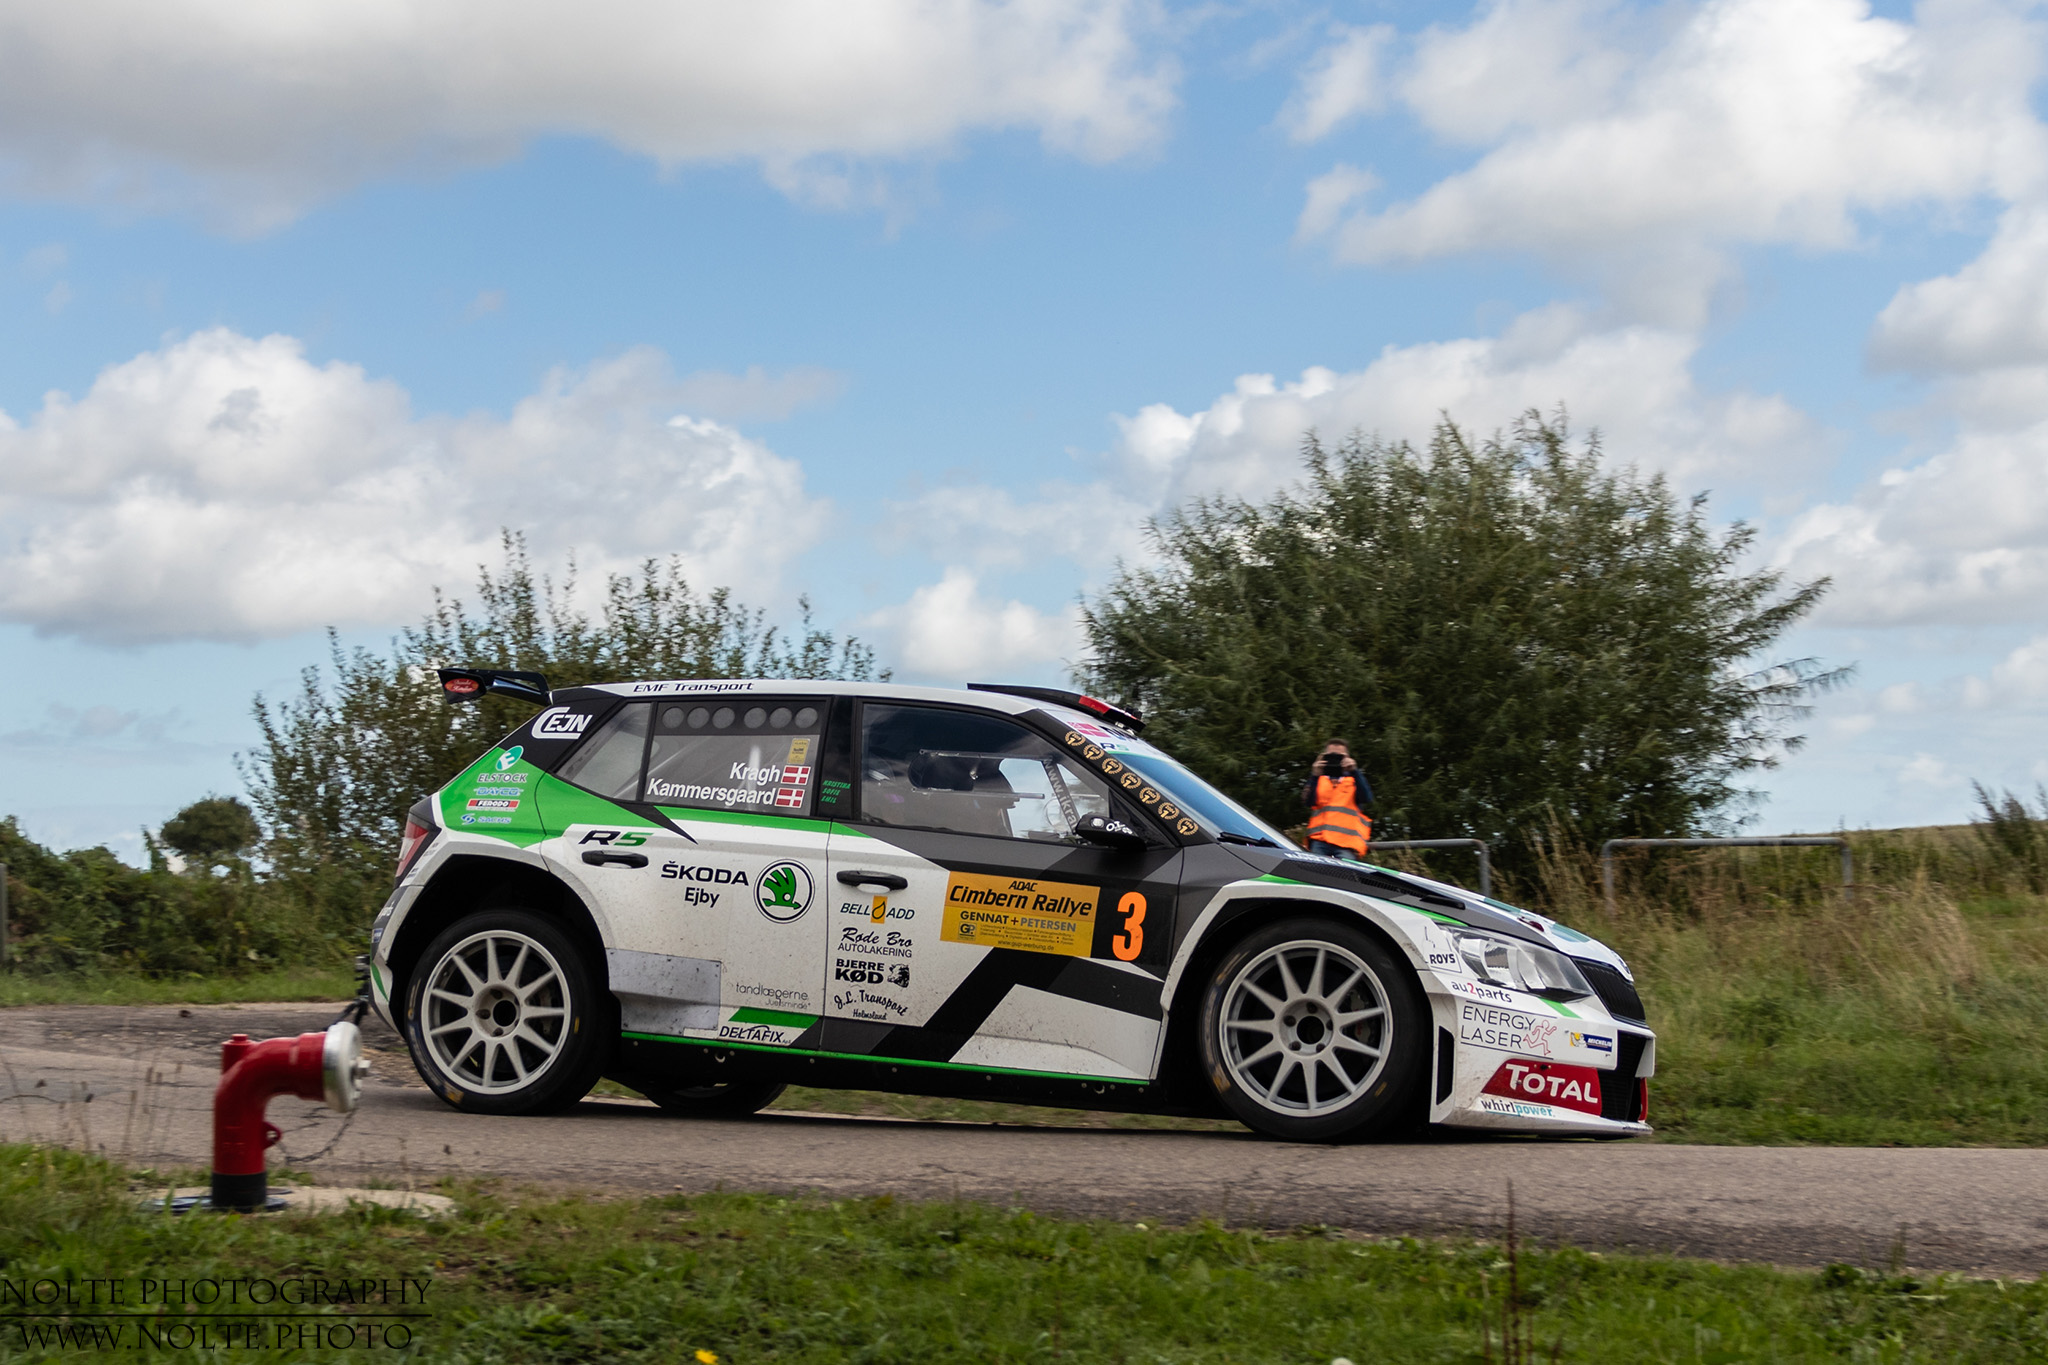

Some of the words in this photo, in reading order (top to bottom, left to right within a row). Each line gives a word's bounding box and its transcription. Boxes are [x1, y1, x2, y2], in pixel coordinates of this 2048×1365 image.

[633, 683, 669, 693] EMF
[674, 682, 754, 694] Transport
[531, 706, 593, 739] CEJN
[477, 773, 528, 783] ELSTOCK
[730, 762, 780, 786] Kragh
[647, 777, 776, 807] Kammersgaard
[578, 830, 654, 847] R5
[661, 860, 749, 886] ŠKODA
[1008, 880, 1038, 892] ADAC
[684, 887, 720, 908] Ejby
[949, 885, 1027, 909] Cimbern
[1032, 894, 1092, 917] Rallye
[840, 902, 871, 916] BELL
[886, 907, 915, 920] ADD
[960, 910, 1009, 925] GENNAT
[1020, 917, 1077, 932] PETERSEN
[1112, 891, 1147, 961] 3
[841, 927, 879, 943] Røde
[886, 931, 913, 947] Bro
[837, 942, 913, 958] AUTOLAKERING
[1429, 953, 1456, 965] ROYS
[835, 968, 884, 984] KØD
[836, 959, 885, 972] BJERRE
[736, 982, 808, 1003] tandlægerne
[1451, 981, 1512, 1003] au2parts
[859, 990, 908, 1016] Transport
[1462, 1005, 1536, 1030] ENERGY
[719, 1025, 784, 1043] DELTAFIX
[1460, 1025, 1522, 1049] LASER
[1588, 1037, 1612, 1047] MICHELIN
[1505, 1063, 1598, 1104] TOTAL
[1481, 1099, 1552, 1117] whirlpower
